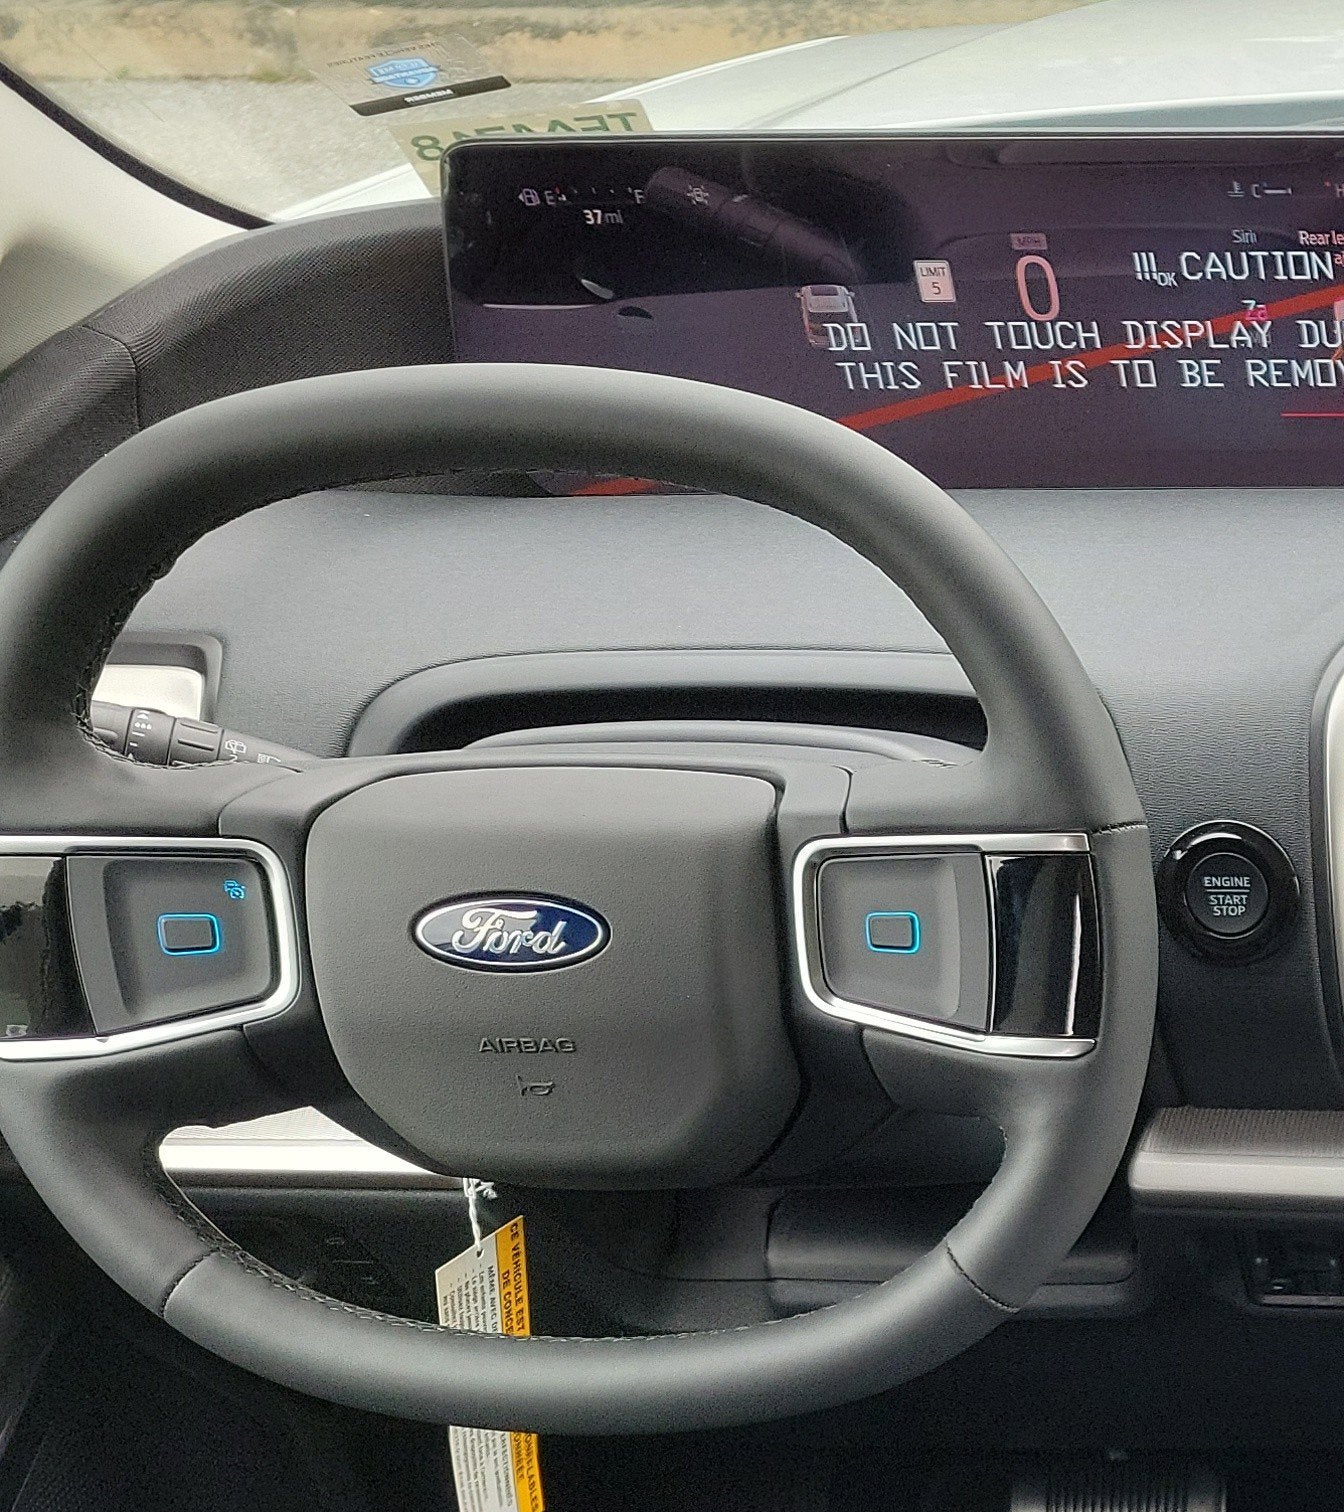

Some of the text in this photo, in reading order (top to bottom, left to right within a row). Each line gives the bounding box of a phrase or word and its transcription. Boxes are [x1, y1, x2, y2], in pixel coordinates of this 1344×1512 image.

[1299, 230, 1330, 245] Rear
[920, 266, 946, 277] LIMIT
[1180, 251, 1334, 280] CAUTION
[931, 281, 942, 295] 5
[1016, 254, 1060, 321] 0
[823, 322, 871, 351] DO
[892, 322, 959, 351] NOT
[985, 321, 1101, 350] TOUCH
[1121, 319, 1272, 349] DISPLAY
[836, 361, 922, 390] THIS
[943, 360, 1028, 390] FILM
[1050, 360, 1088, 388] IS
[1110, 359, 1157, 388] TO
[1177, 359, 1225, 387] BE
[1204, 877, 1250, 887] ENGINE
[1209, 895, 1248, 905] START
[1213, 906, 1246, 916] STOP
[451, 907, 567, 954] Ford
[479, 1037, 577, 1053] AIRBAG
